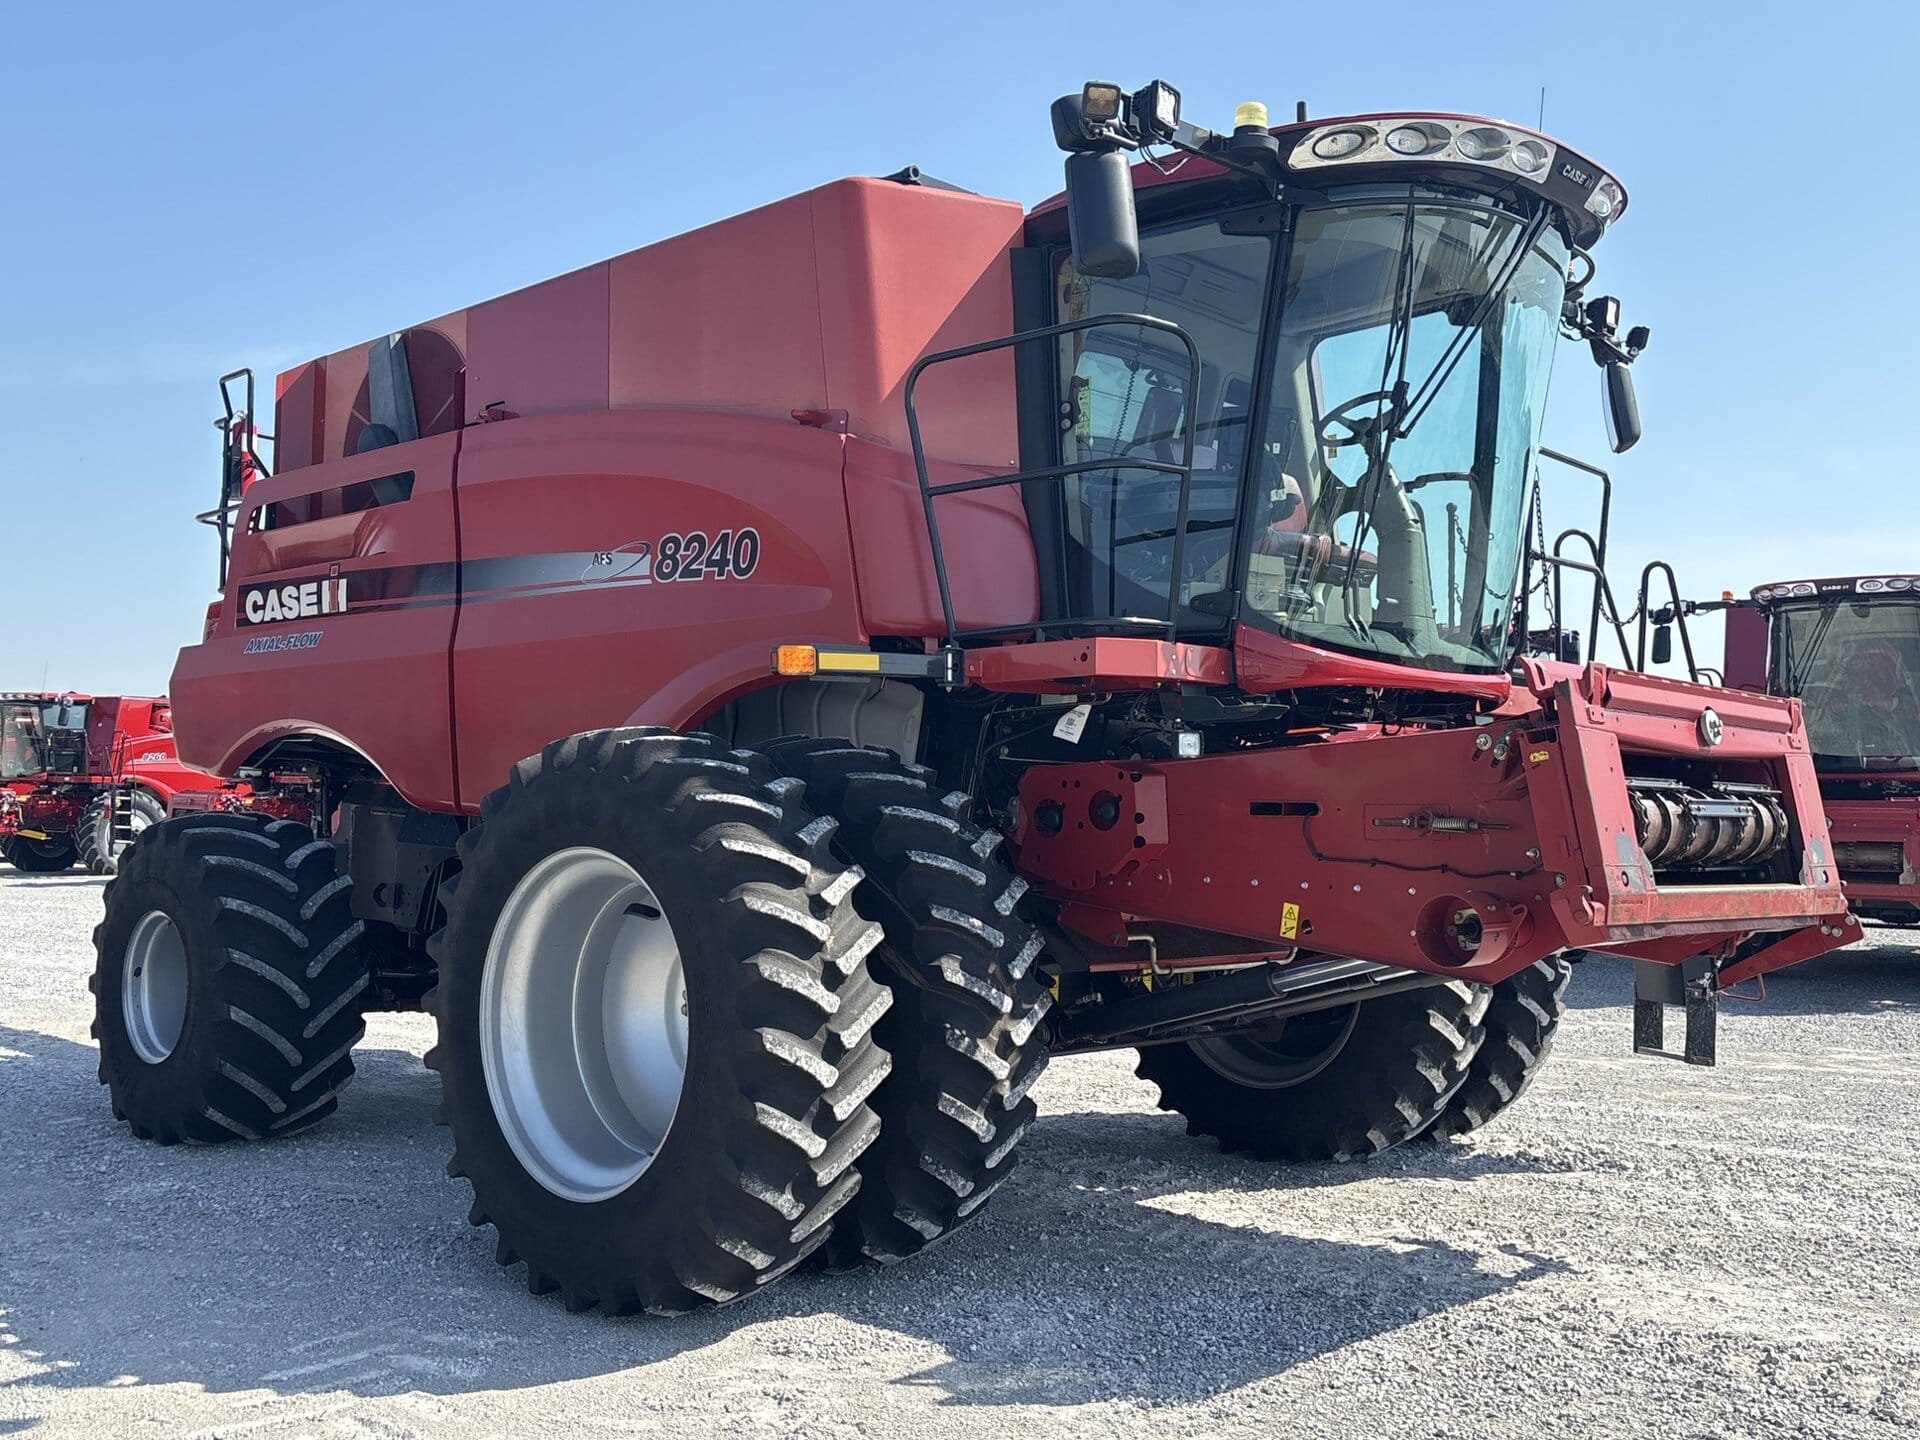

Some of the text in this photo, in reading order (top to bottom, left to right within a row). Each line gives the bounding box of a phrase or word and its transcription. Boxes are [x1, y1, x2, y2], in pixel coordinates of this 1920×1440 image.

[1562, 164, 1587, 185] CASE
[592, 551, 613, 566] AFS
[653, 527, 760, 583] 8240
[245, 582, 319, 624] CASE
[243, 631, 324, 655] AXIAL-FLOW
